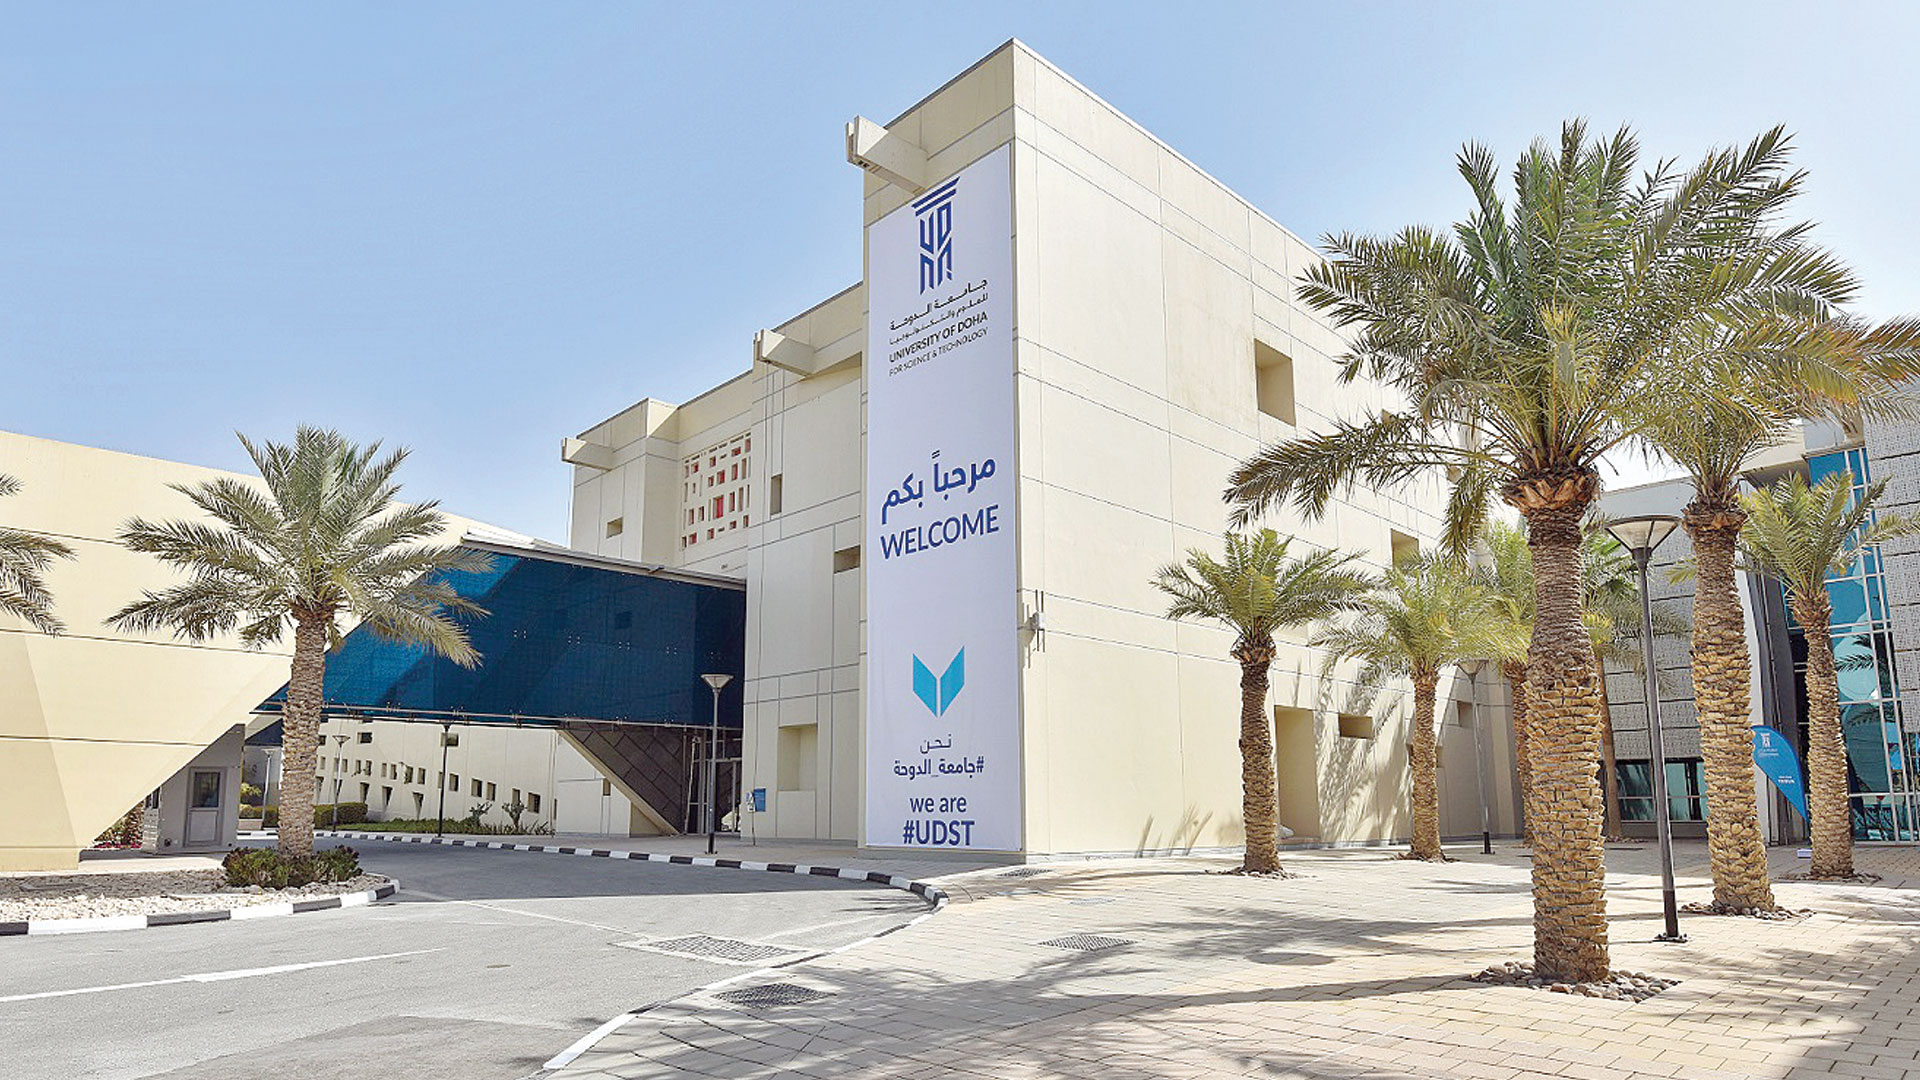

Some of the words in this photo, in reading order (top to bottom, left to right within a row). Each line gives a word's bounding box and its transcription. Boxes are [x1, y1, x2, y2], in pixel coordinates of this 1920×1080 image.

[934, 279, 988, 309] جامعة
[889, 330, 942, 362] UNIVERSITY
[942, 324, 956, 339] OF
[957, 311, 988, 333] DOHA
[889, 364, 903, 377] FOR
[903, 351, 932, 369] SCIENCE
[932, 350, 937, 358] &
[938, 326, 988, 355] TECHNOLOGY
[881, 472, 924, 525] بكم
[880, 504, 999, 560] WELCOME
[920, 733, 952, 754] نحن
[909, 797, 935, 813] we
[939, 796, 967, 813] are
[902, 820, 975, 846] #UDST
